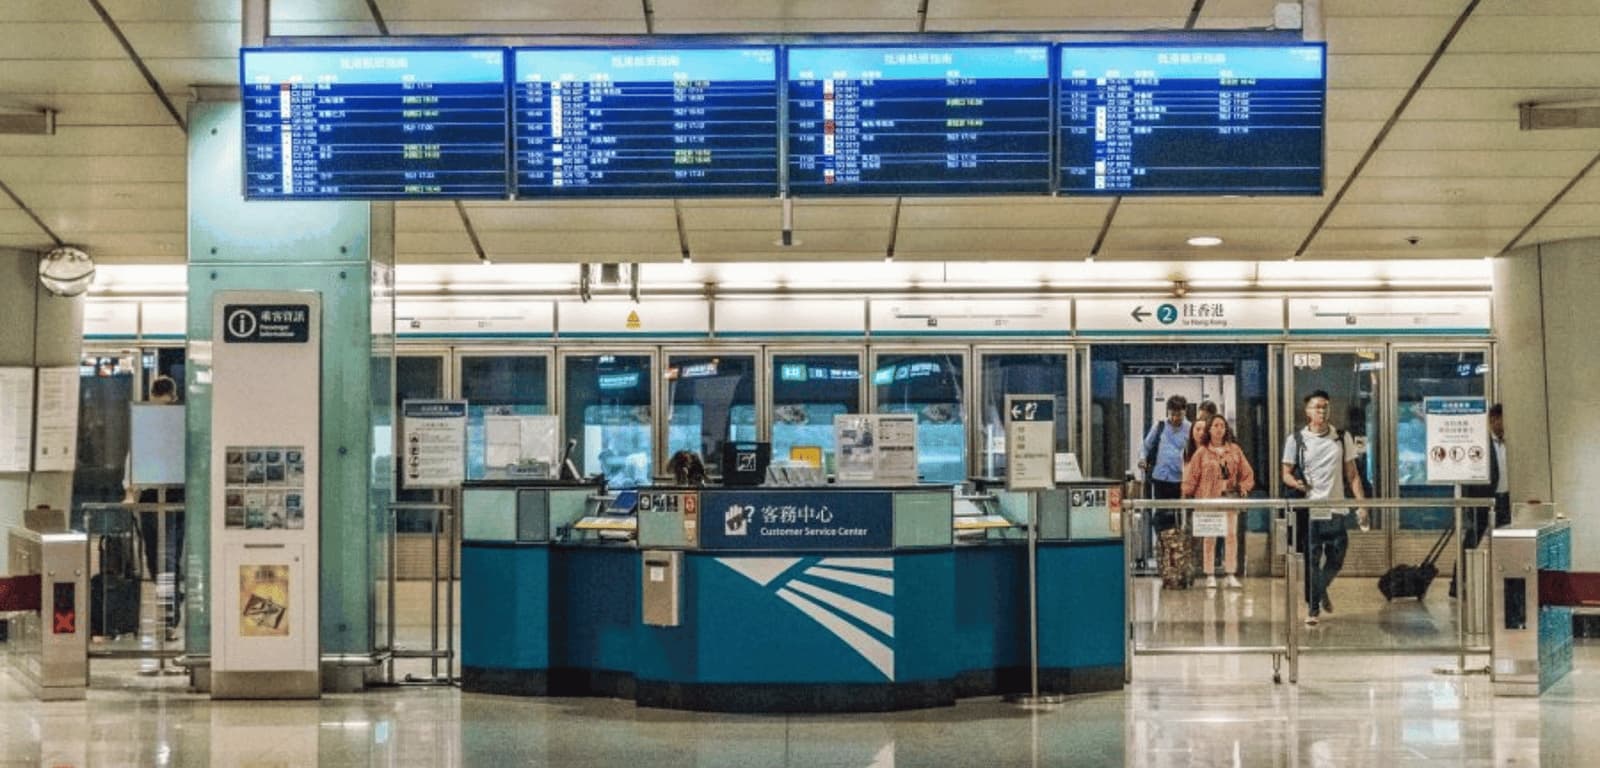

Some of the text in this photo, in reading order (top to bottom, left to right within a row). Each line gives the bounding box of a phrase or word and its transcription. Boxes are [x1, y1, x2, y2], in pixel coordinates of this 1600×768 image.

[1163, 307, 1173, 321] 2
[761, 504, 834, 523] 客務中心
[760, 527, 868, 536] Customer Service Center
